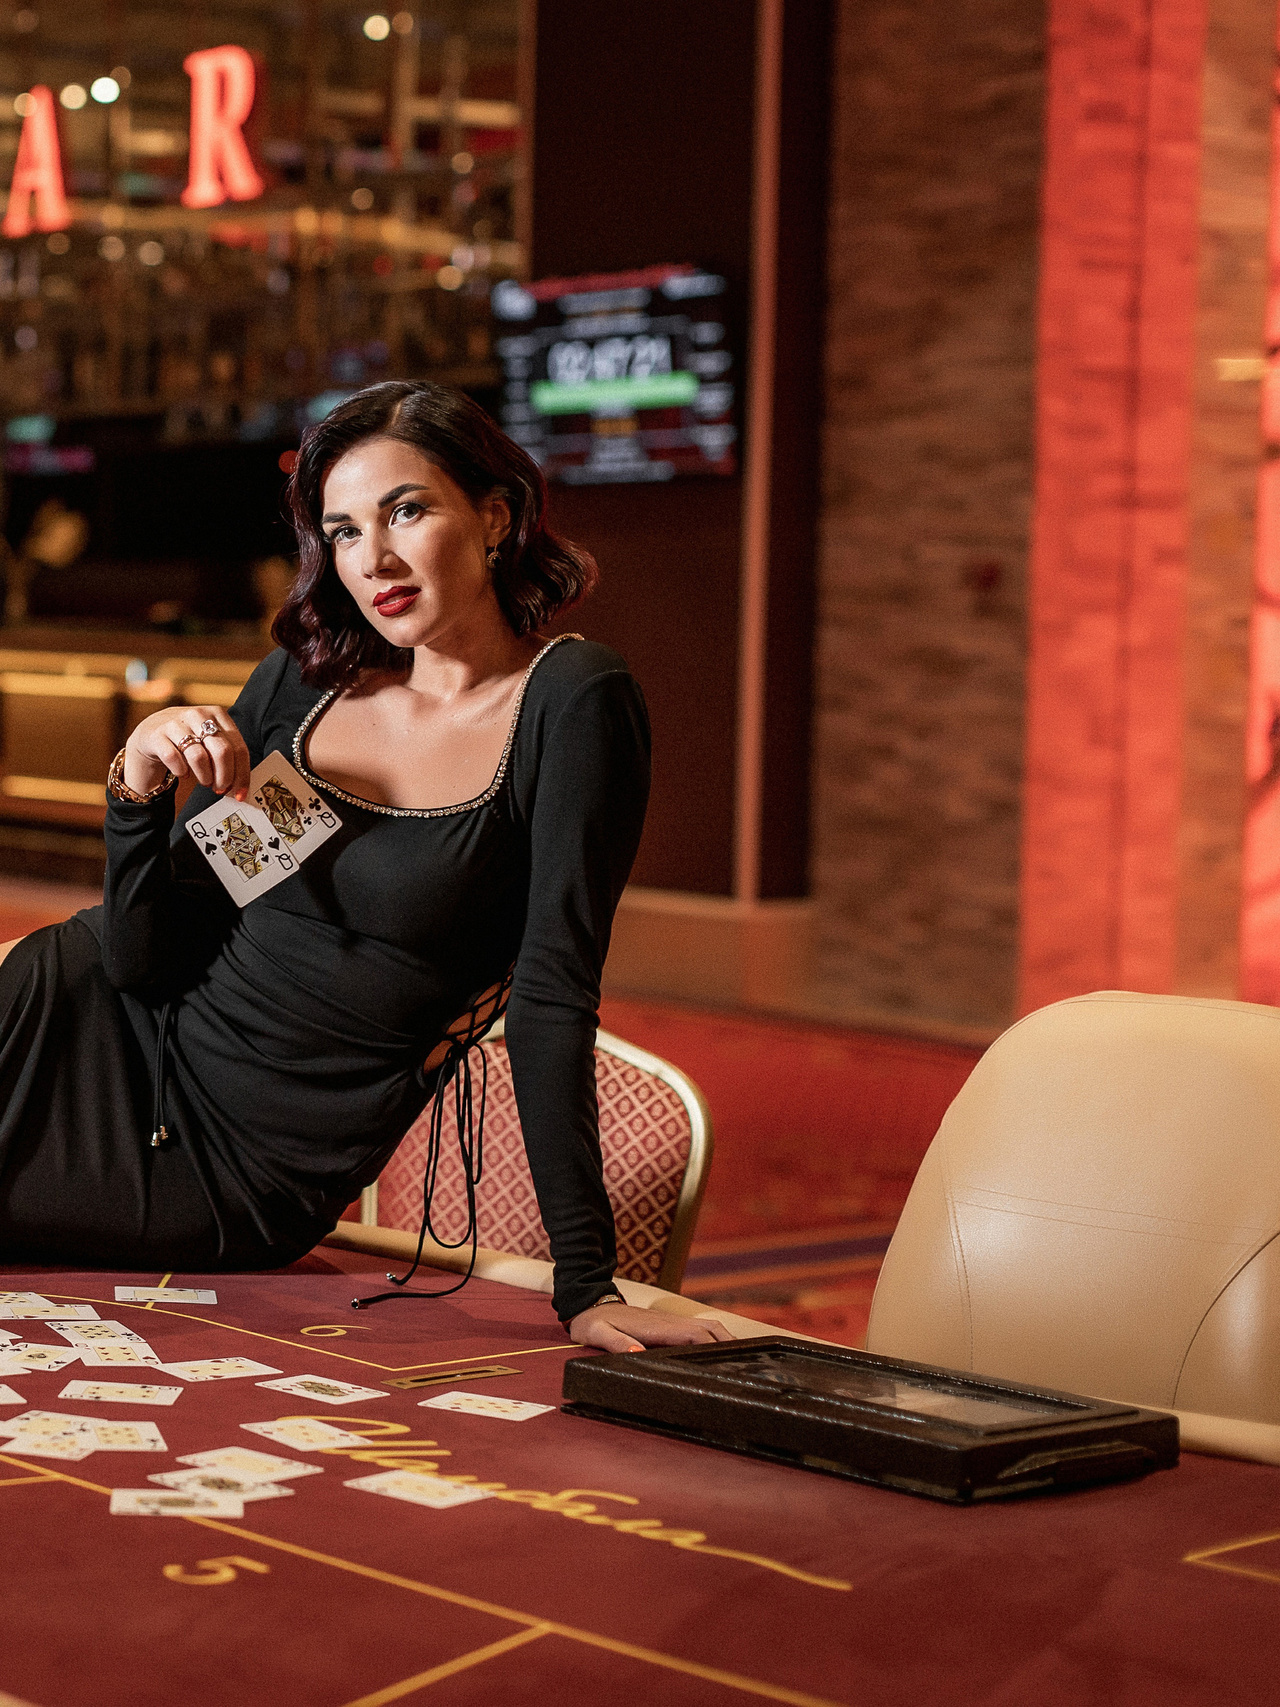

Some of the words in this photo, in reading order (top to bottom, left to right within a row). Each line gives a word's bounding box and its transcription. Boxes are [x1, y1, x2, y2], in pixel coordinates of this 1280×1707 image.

[316, 811, 337, 829] Q
[191, 821, 210, 839] Q
[275, 853, 294, 871] Q
[162, 1554, 270, 1587] 5
